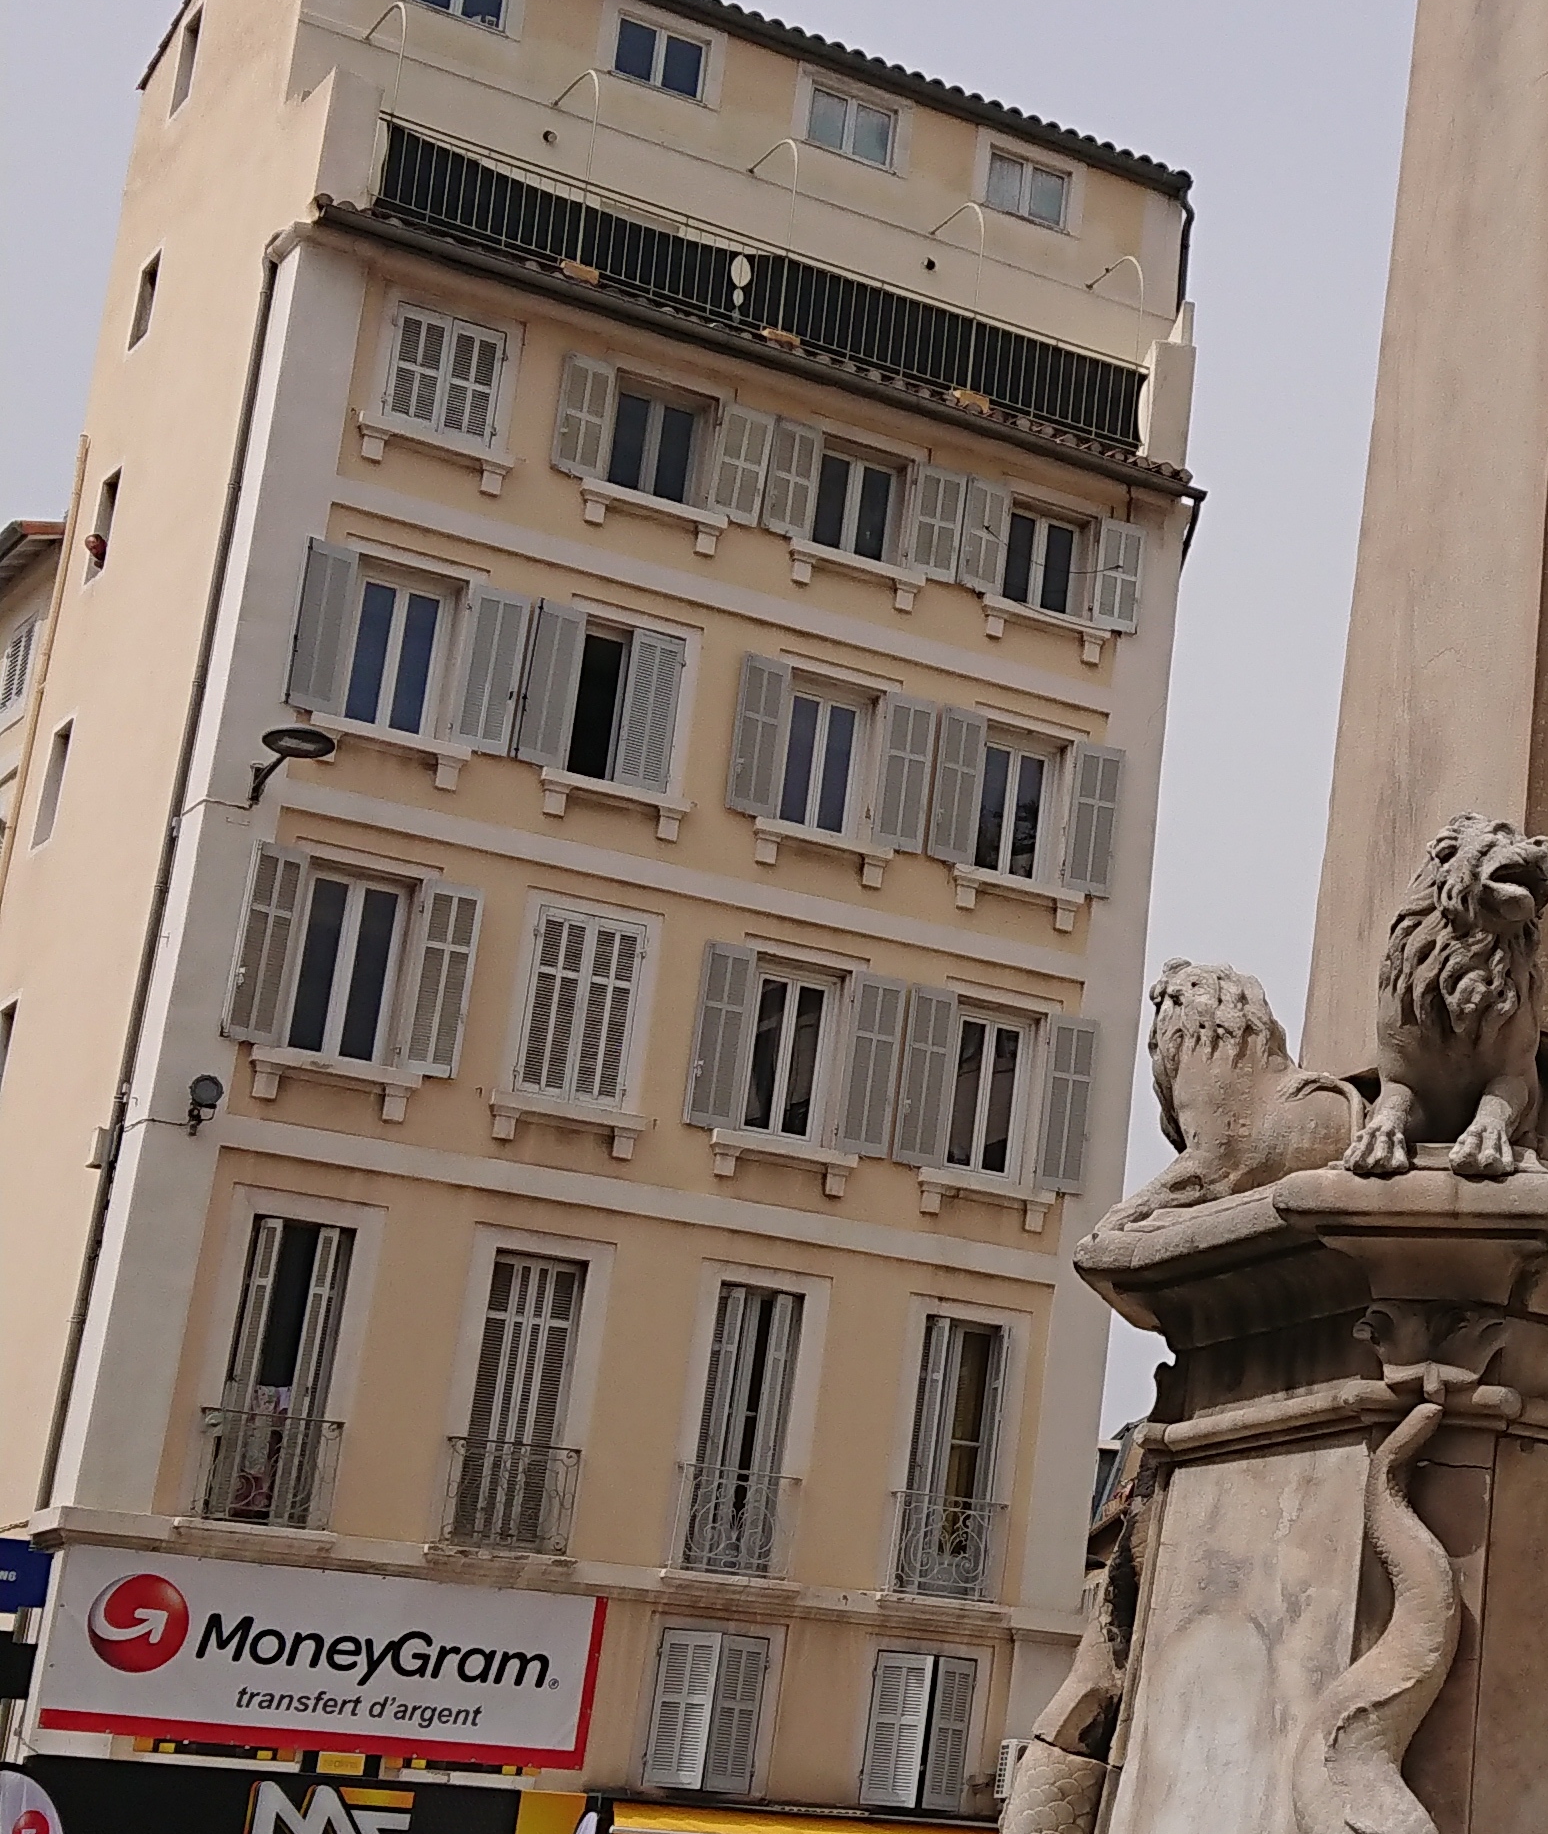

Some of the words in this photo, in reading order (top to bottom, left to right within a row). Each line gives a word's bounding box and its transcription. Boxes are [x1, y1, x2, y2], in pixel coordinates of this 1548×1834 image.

[195, 1613, 549, 1689] MoneyGram
[235, 1686, 362, 1718] transfert
[368, 1696, 483, 1728] d'argent
